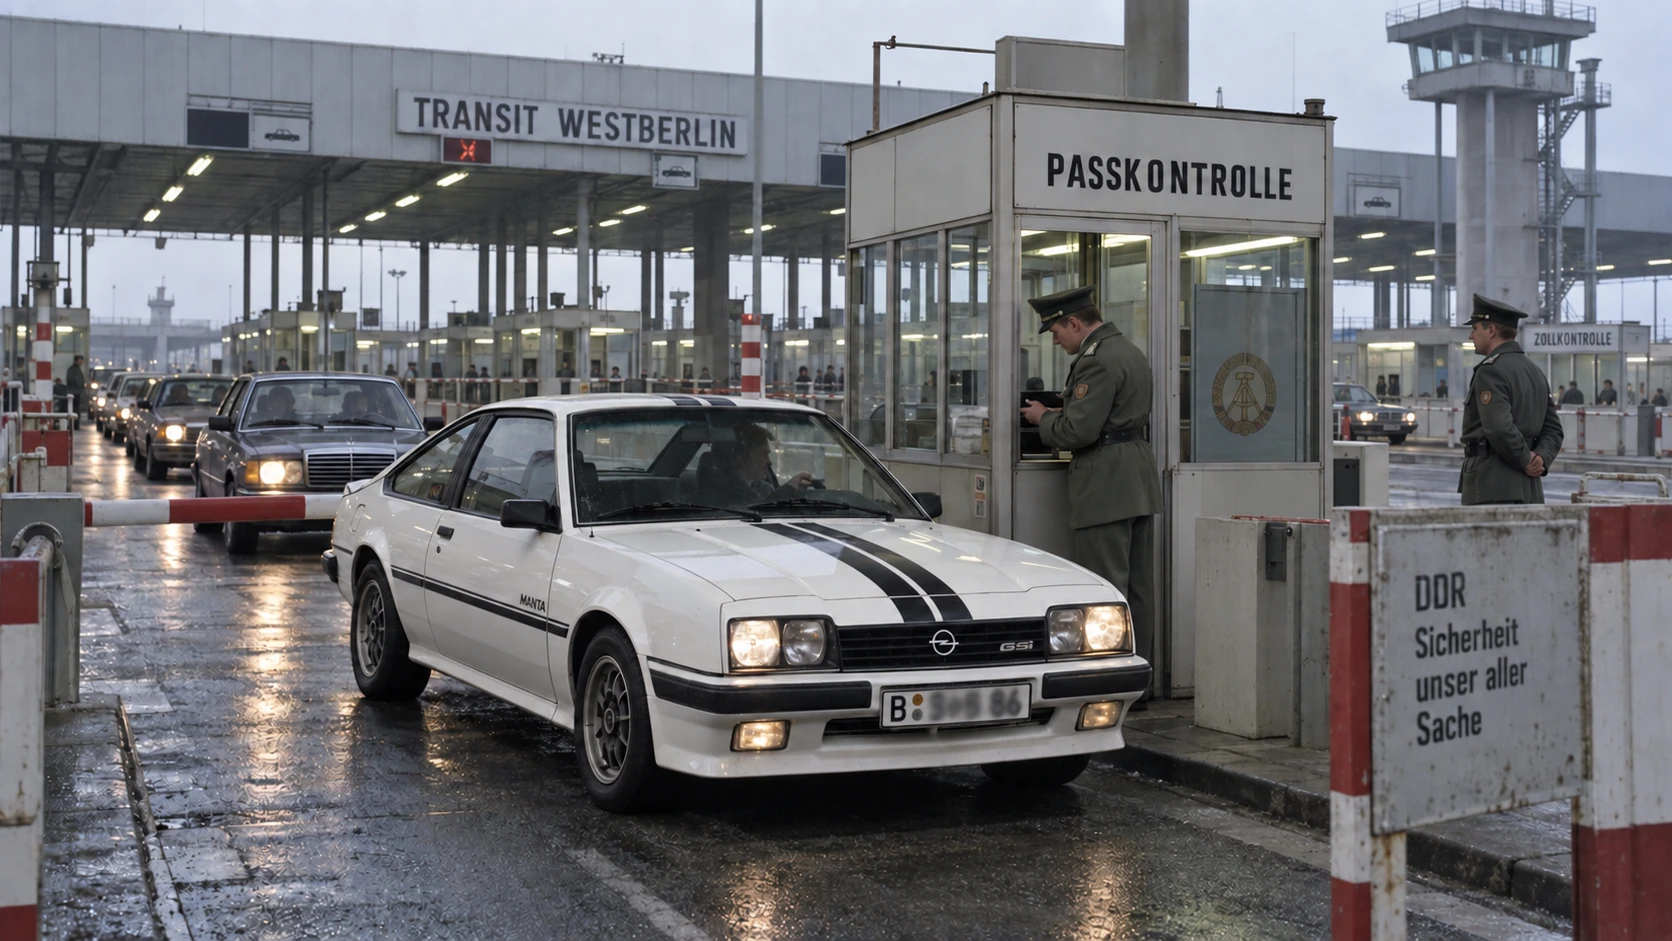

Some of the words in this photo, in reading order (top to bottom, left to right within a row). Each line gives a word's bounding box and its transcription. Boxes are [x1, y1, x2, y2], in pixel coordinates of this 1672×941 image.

[413, 97, 539, 135] TRANSIT
[558, 108, 737, 149] WESTBERLIN
[1047, 152, 1293, 201] PASSKONTROLLE
[1534, 331, 1612, 347] ZOLLKONTROLLE
[519, 593, 546, 612] MANTA
[1415, 571, 1466, 612] DDR
[999, 641, 1034, 652] GSi
[1415, 617, 1519, 659] Sicherheit
[1416, 669, 1478, 703] unser
[1485, 656, 1528, 691] aller
[890, 695, 907, 723] B
[1416, 705, 1483, 746] Sache
